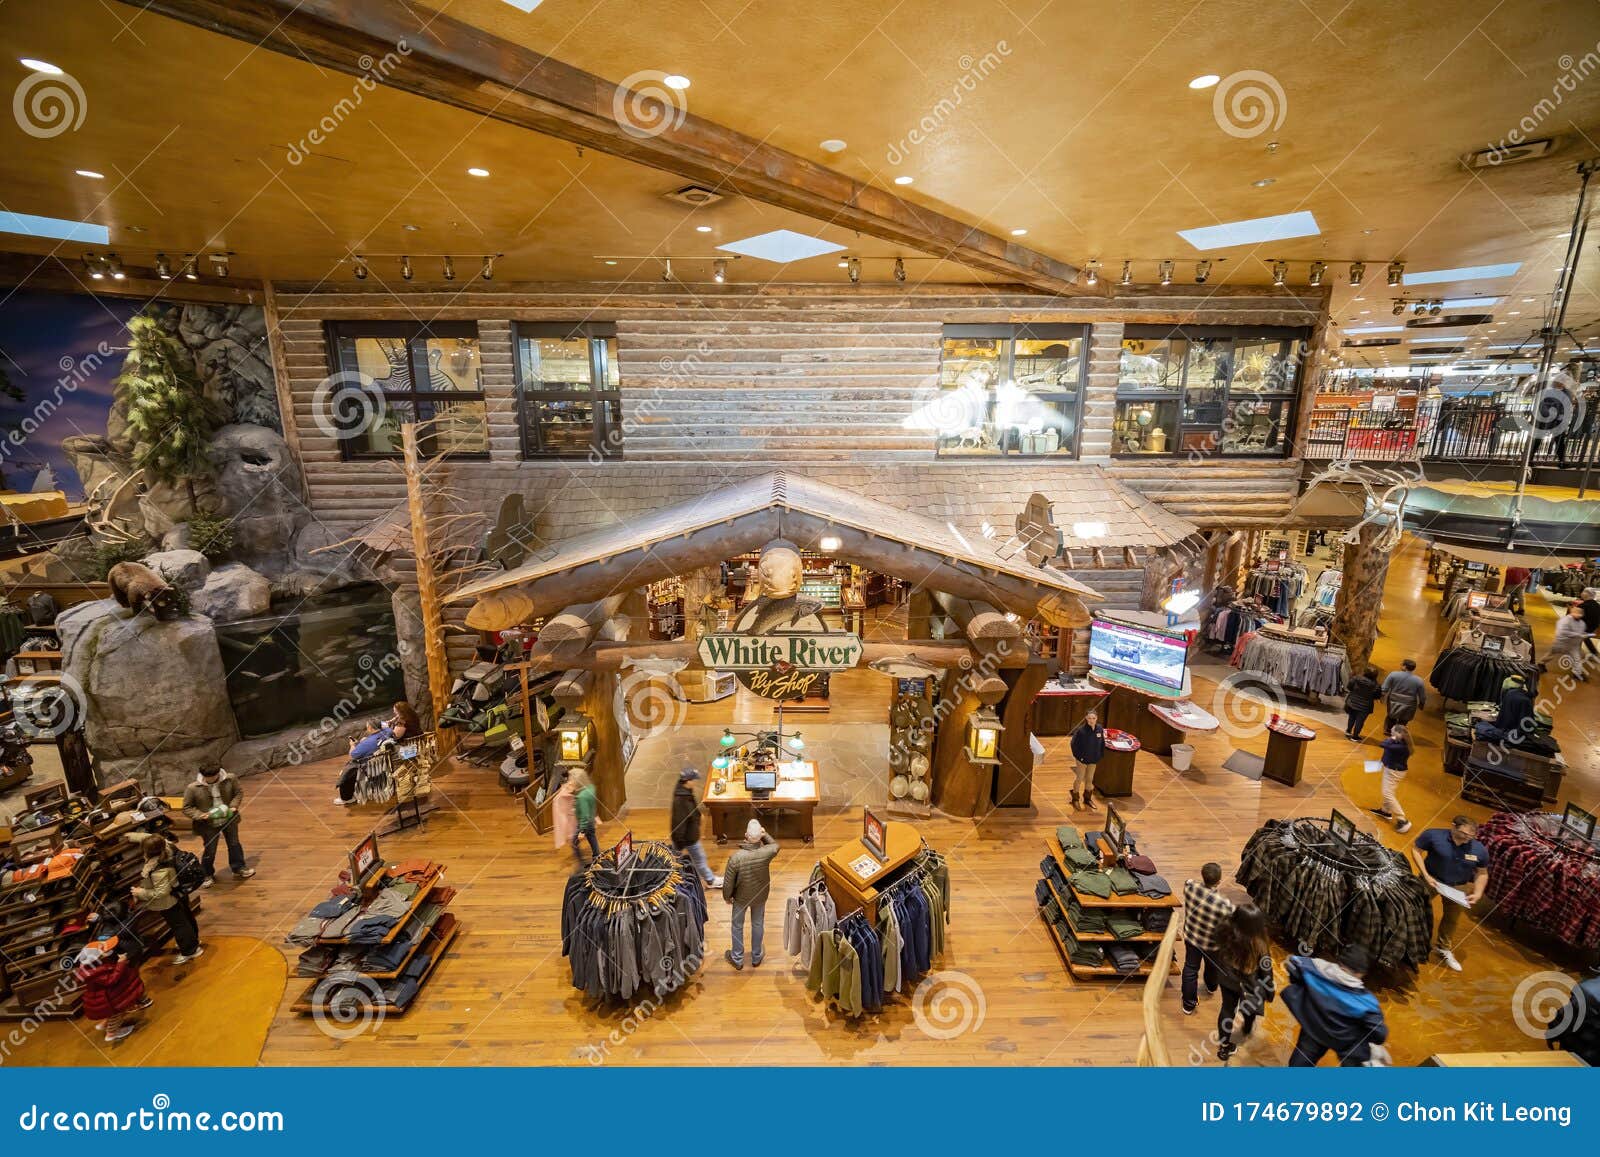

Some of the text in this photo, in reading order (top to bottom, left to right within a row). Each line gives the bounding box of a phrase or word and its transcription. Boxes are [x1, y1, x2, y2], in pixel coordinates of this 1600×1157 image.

[705, 637, 857, 667] White River
[750, 670, 819, 698] Fly Shop
